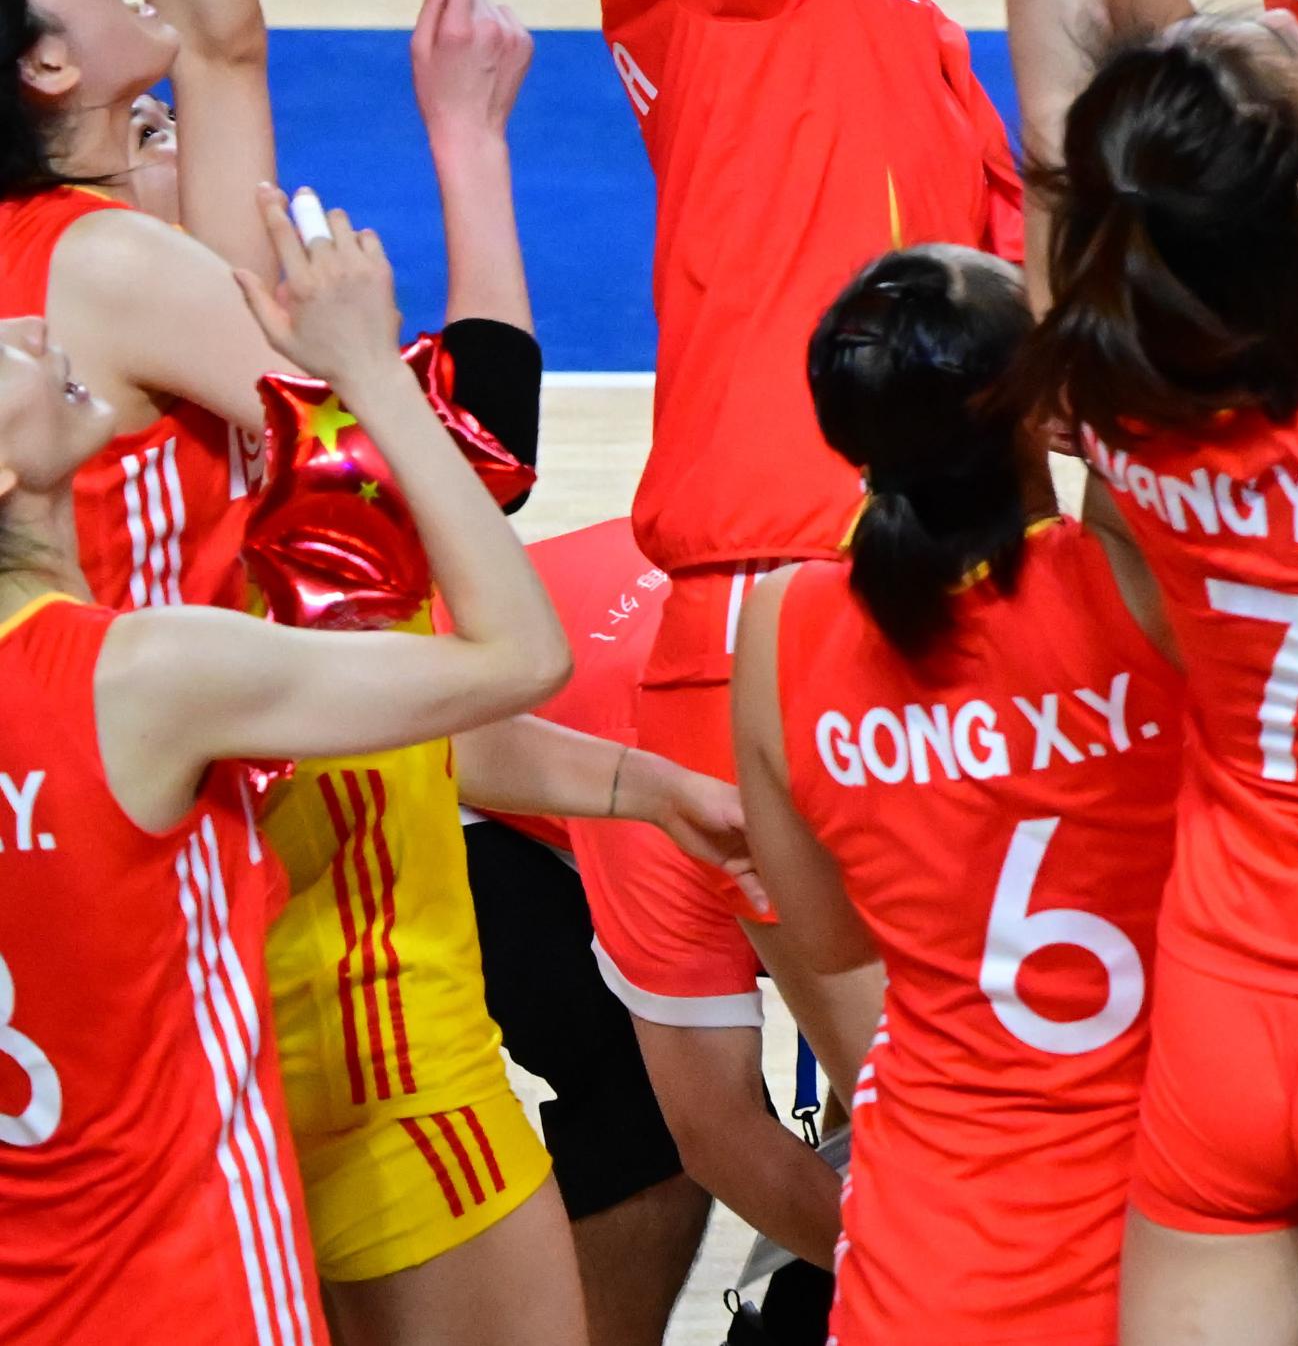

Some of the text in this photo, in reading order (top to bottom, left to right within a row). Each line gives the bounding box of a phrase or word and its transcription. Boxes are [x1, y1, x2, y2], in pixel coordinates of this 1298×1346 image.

[815, 673, 1159, 787] GONG X.Y.
[978, 817, 1144, 1055] 6
